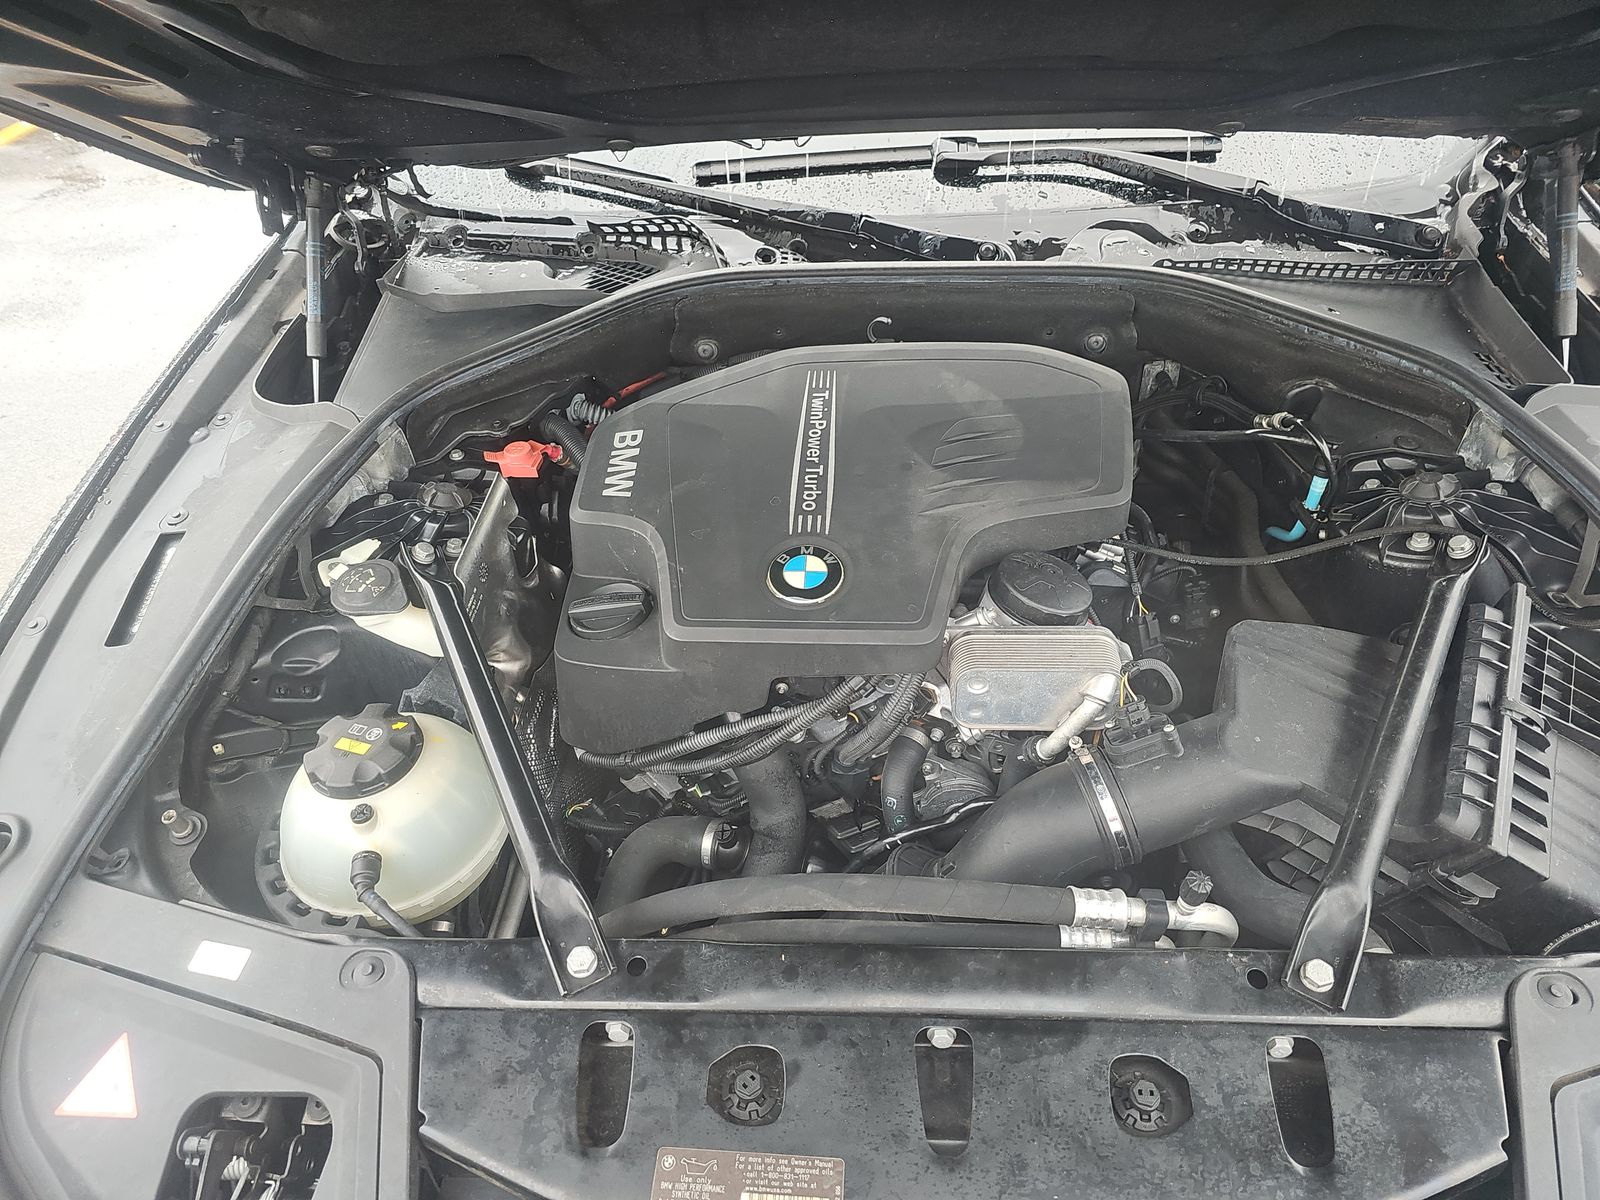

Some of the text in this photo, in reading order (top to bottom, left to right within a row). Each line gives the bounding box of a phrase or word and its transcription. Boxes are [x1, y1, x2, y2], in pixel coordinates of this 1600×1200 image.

[802, 390, 829, 510] TwinPower Turbo
[602, 430, 643, 497] BMW
[777, 546, 837, 564] BMW
[736, 1154, 745, 1162] For
[765, 1156, 775, 1164] info
[790, 1157, 812, 1166] Owner's
[814, 1159, 833, 1168] Manual
[754, 1163, 764, 1171] list
[795, 1167, 819, 1175] approved
[680, 1174, 712, 1185] Use only
[660, 1181, 726, 1193] BMW HIGH PERFORMANCE
[671, 1190, 711, 1200] SYNTHETIC OIL
